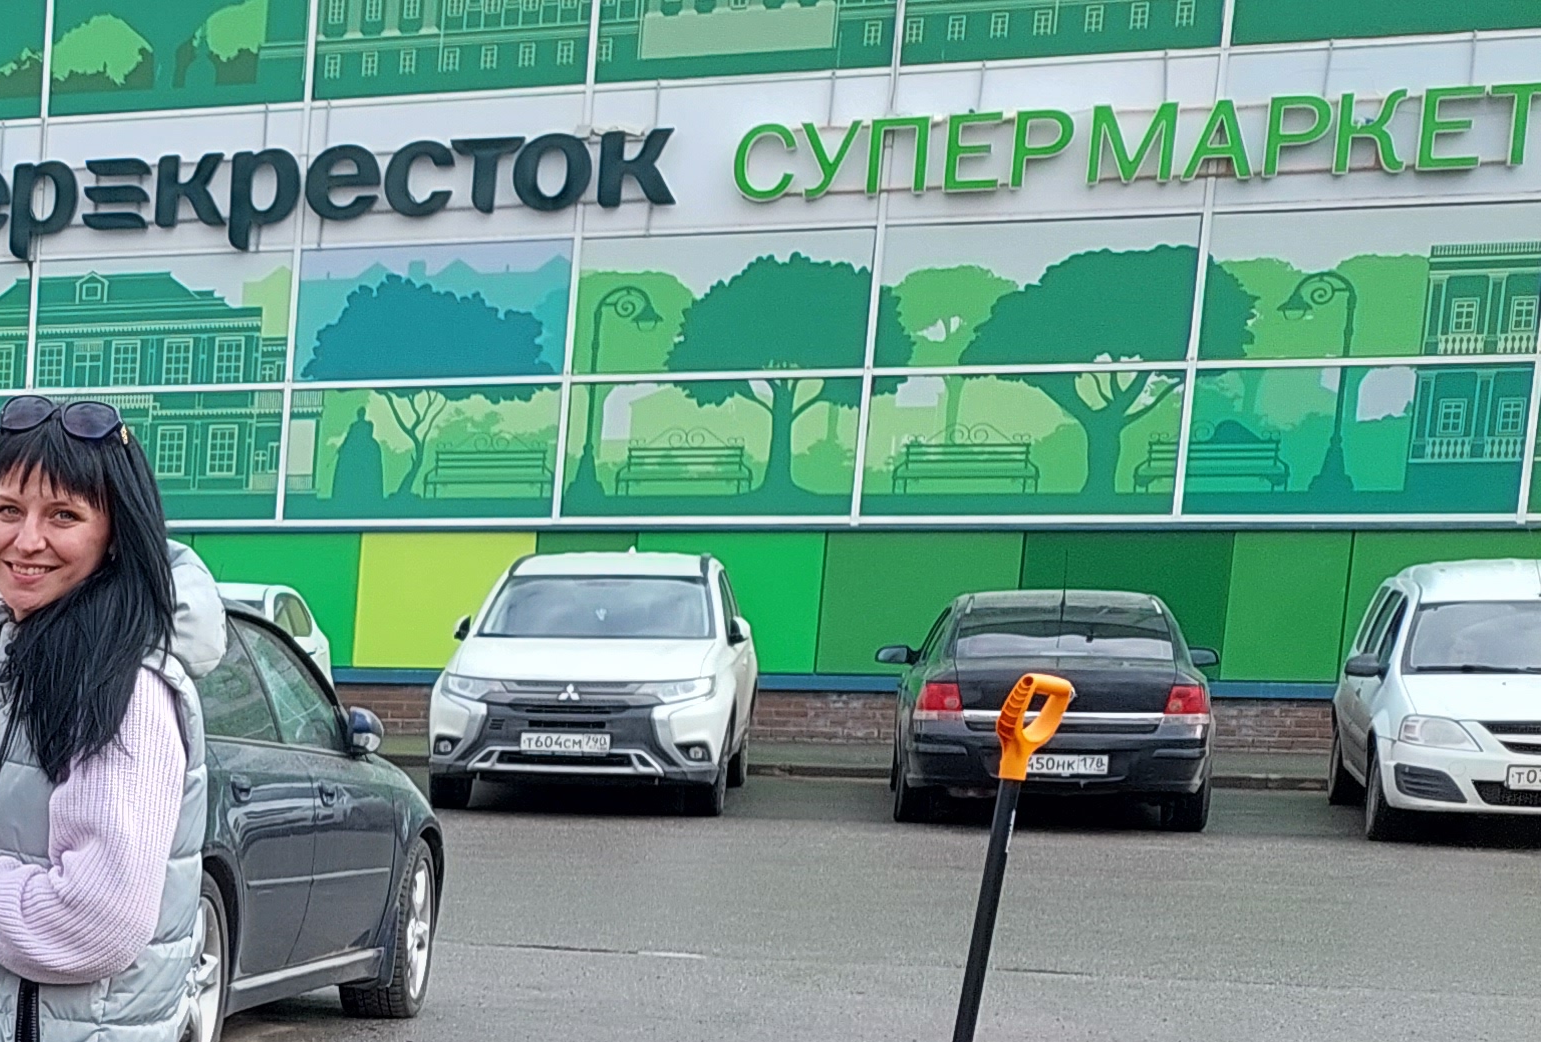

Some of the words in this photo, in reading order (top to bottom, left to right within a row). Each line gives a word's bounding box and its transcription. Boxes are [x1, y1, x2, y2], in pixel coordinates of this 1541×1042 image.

[731, 82, 1541, 203] СУПЕРМАРКЕТ
[526, 735, 582, 749] Т604СМ
[1028, 756, 1076, 771] 450НК
[1515, 769, 1541, 785] Т0
